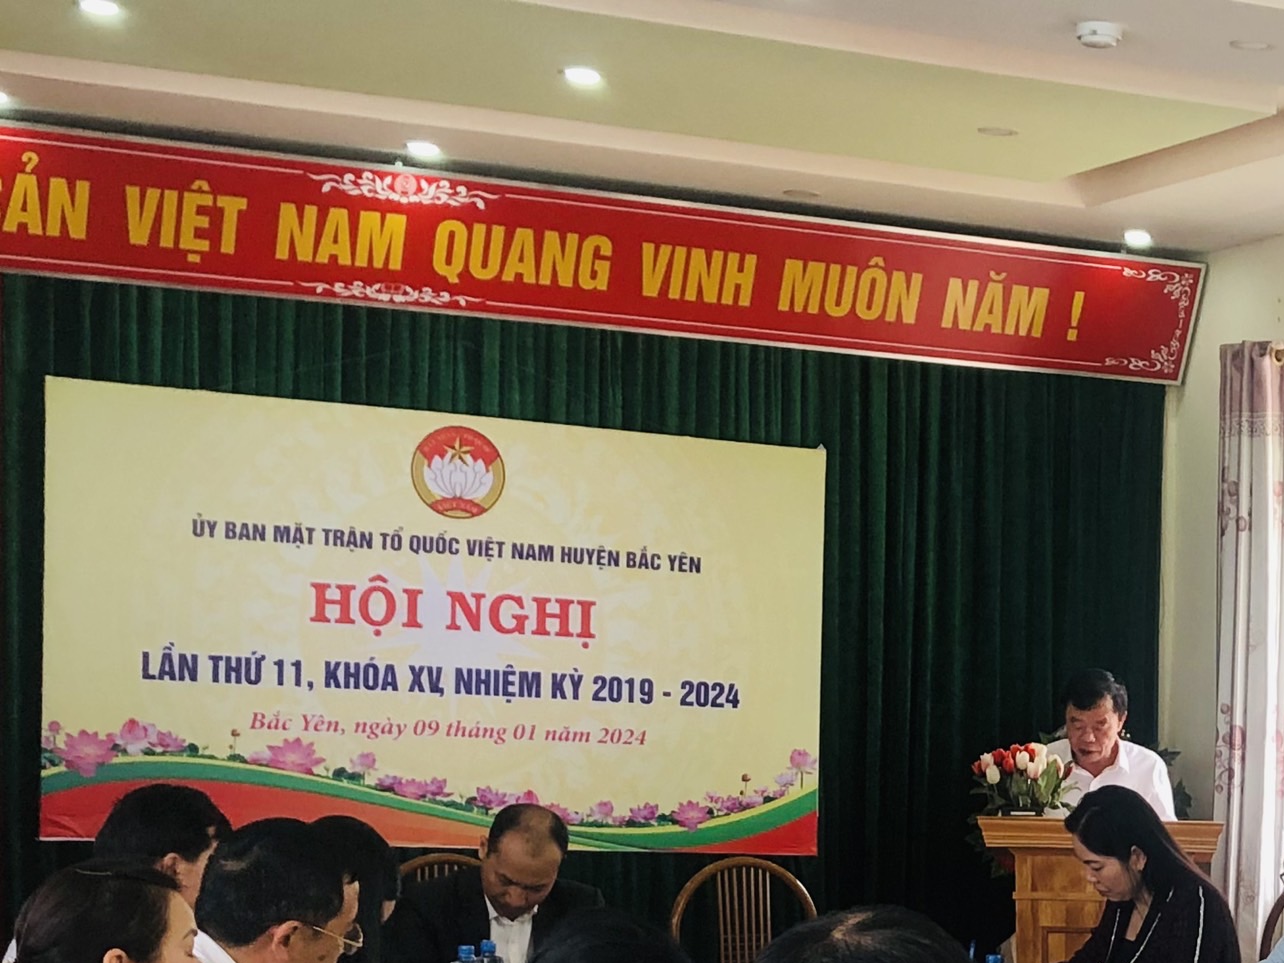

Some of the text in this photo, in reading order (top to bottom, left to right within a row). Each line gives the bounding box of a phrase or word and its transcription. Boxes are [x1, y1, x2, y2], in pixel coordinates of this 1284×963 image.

[0, 151, 1085, 342] ẢN VIỆT NAM QUANG VINH MUÔN NĂM !
[192, 513, 702, 574] ỦY BAN MẶT TRẬN TỔ QUỐC VIỆT NAM HUYỆN BẮC YÊN
[309, 574, 597, 649] HỘI NGHỊ
[141, 641, 198, 682] LẦN
[208, 650, 266, 686] THỨ
[272, 658, 314, 692] 11,
[324, 656, 399, 692] KHÓA
[454, 664, 542, 703] NHIỆM
[551, 667, 583, 700] KỲ
[592, 675, 654, 705] 2019
[679, 680, 740, 709] 2024
[250, 710, 647, 745] Bắc Yên, ngày 09 tháng 01 năm 2024
